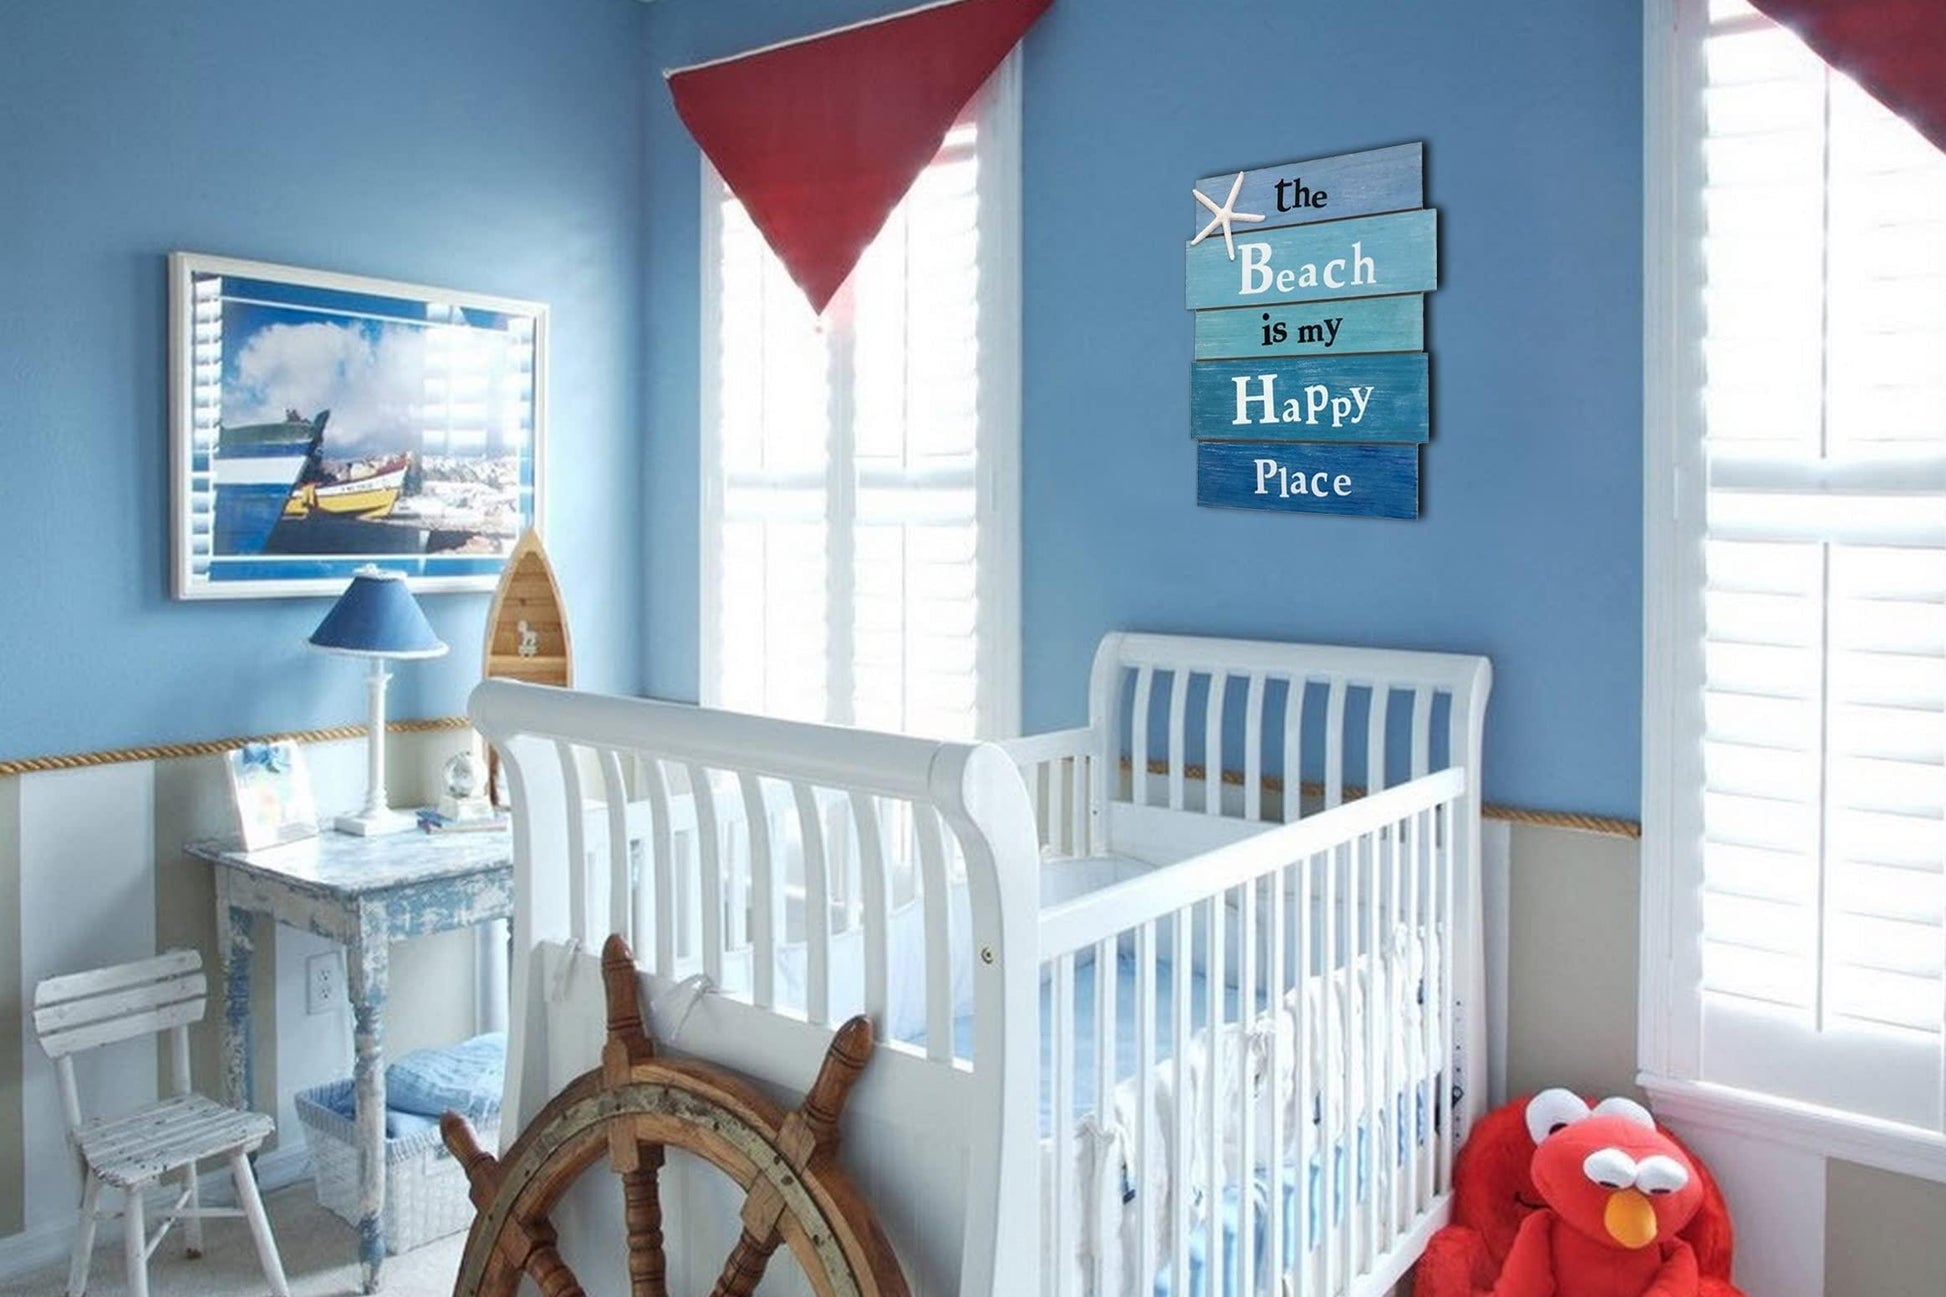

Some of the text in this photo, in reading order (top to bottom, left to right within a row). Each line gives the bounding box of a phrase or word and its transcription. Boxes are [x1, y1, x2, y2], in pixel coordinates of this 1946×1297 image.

[1274, 177, 1328, 213] the
[1237, 240, 1377, 295] Beach
[1261, 312, 1343, 347] is my
[1231, 373, 1375, 428] Happy
[1254, 458, 1352, 499] Place
